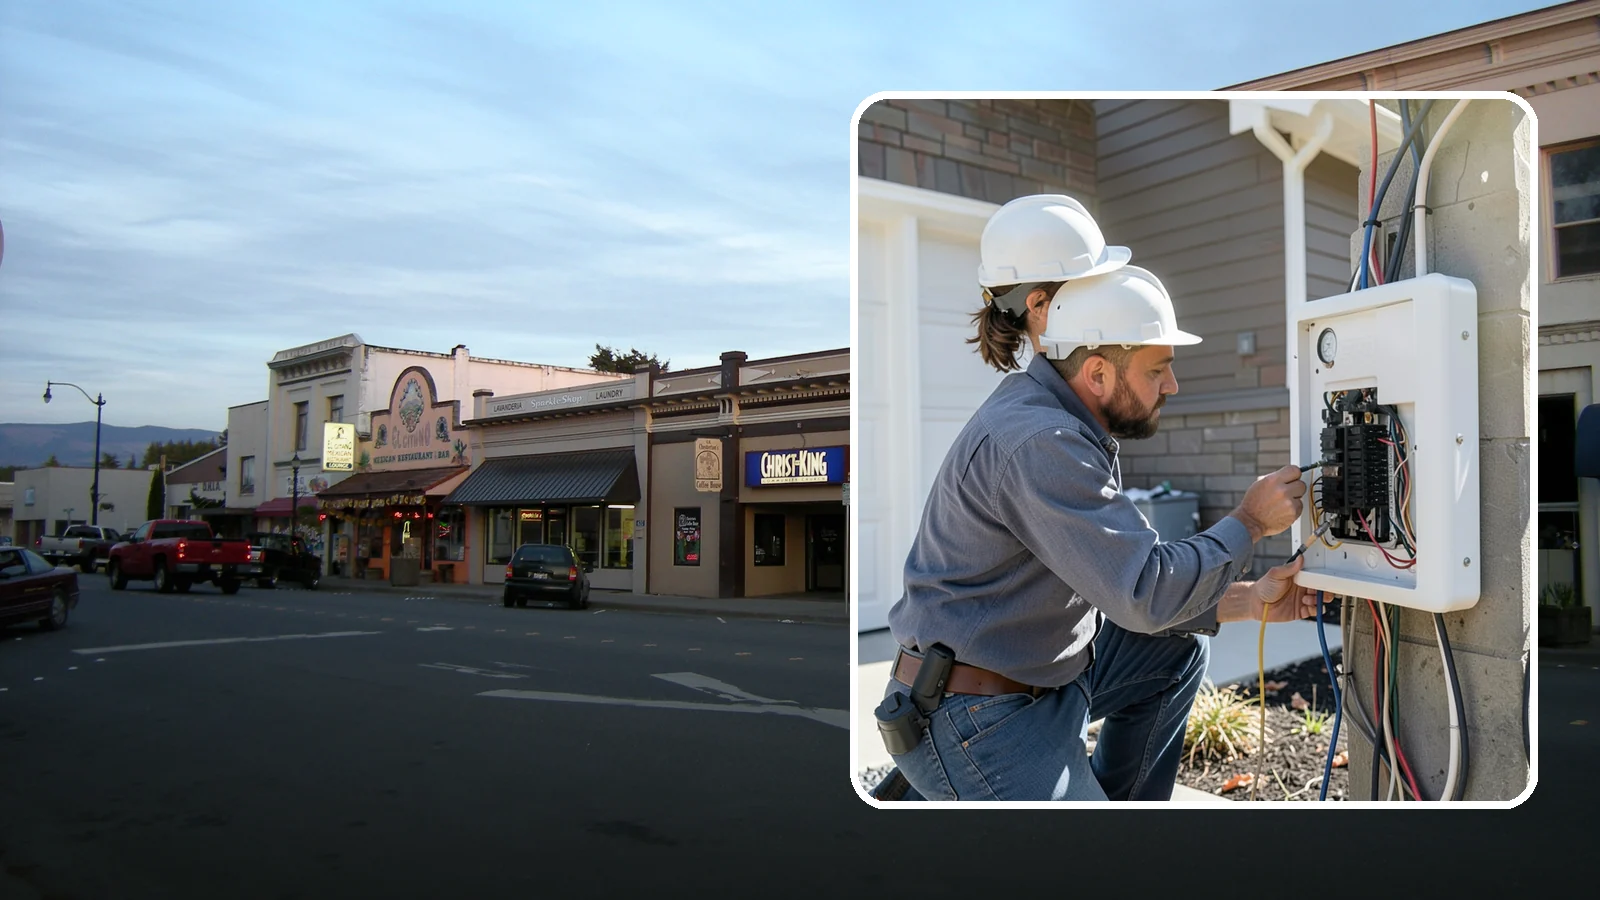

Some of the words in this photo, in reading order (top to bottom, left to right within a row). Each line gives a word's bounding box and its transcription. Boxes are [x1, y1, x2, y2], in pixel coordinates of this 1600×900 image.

[595, 389, 624, 399] LAUNDRY
[494, 402, 522, 412] LAVANDERIA
[531, 397, 560, 409] Sparkle
[561, 394, 583, 406] Shop
[374, 454, 396, 464] MEXICAN
[397, 451, 433, 463] RESTAURANT
[438, 450, 450, 460] BAR
[799, 450, 827, 476] KING
